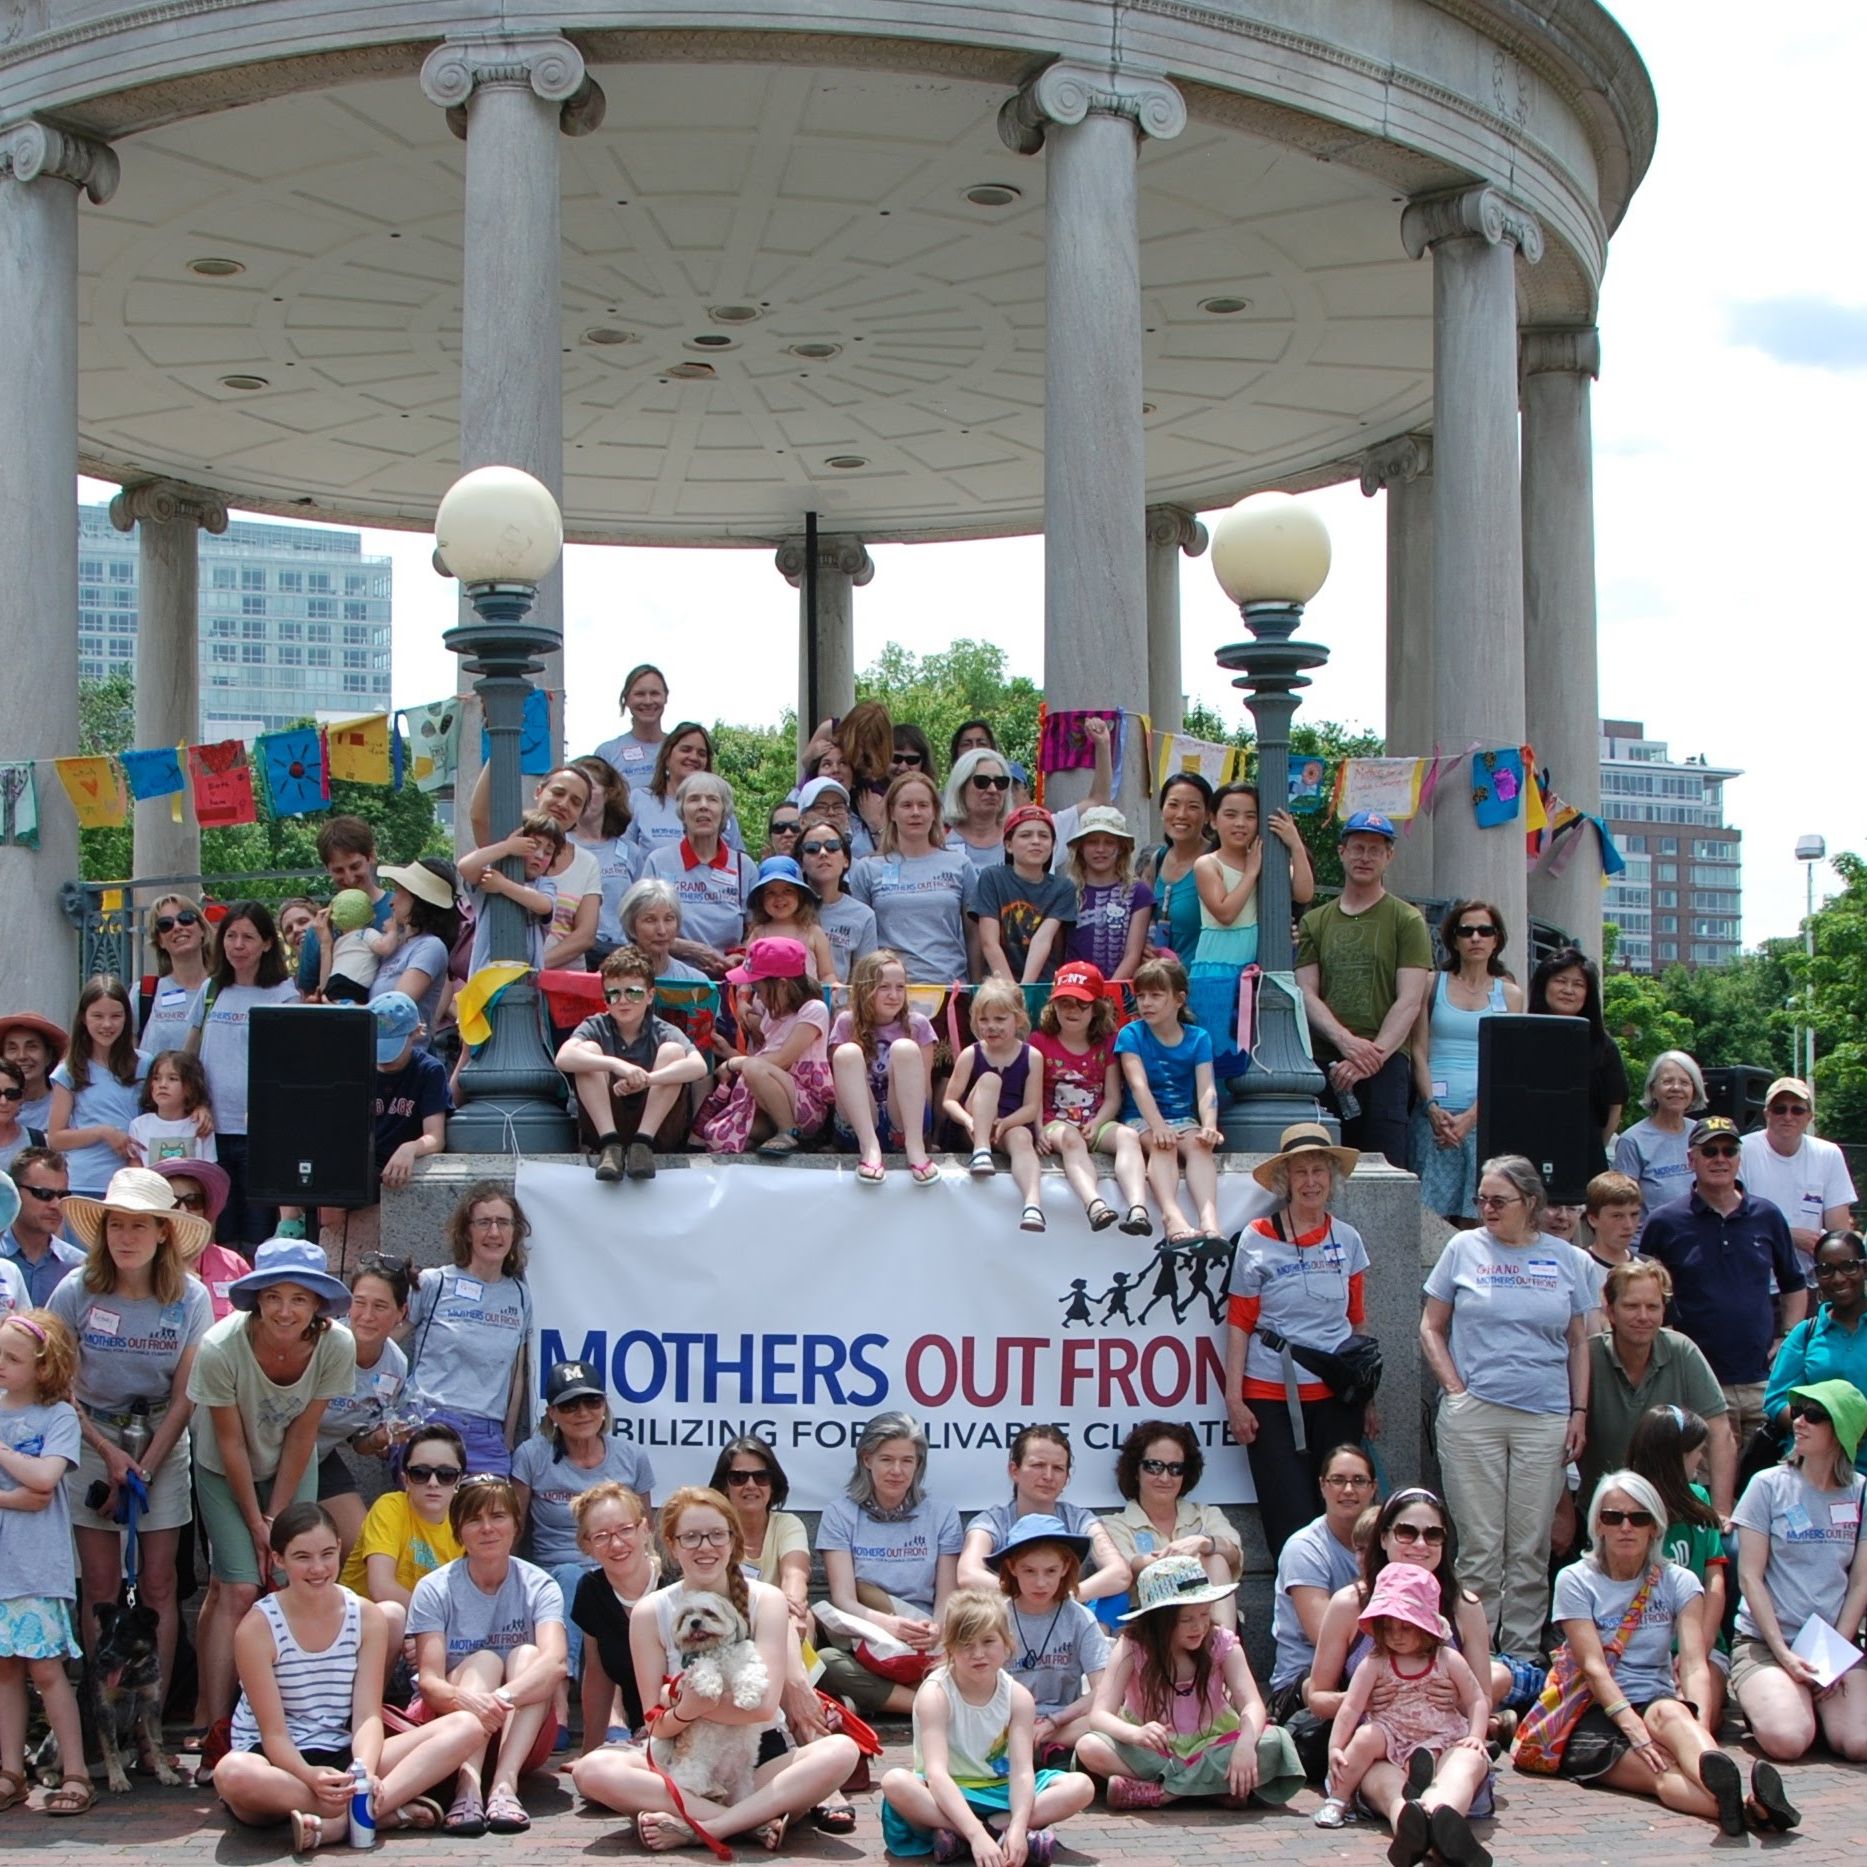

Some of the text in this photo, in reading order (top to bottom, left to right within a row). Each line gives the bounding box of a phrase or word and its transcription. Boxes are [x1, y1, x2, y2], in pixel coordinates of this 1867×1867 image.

[679, 892, 703, 901] THERS
[1477, 1264, 1520, 1275] GRAND
[1476, 1275, 1515, 1285] MOTHERS
[84, 1333, 127, 1348] MOTHERS
[128, 1336, 147, 1349] OUT
[148, 1339, 178, 1351] FRONT
[540, 1329, 1228, 1407] MOTHERS OUT FRON
[563, 1364, 584, 1382] M
[541, 1417, 777, 1448] BILIZING
[924, 1421, 1070, 1449] LIVAB
[1083, 1420, 1241, 1450] CLATE
[1826, 1528, 1842, 1539] OUT
[1843, 1529, 1857, 1540] FRO
[886, 1547, 902, 1558] OUT
[903, 1547, 928, 1557] FRONT
[1670, 1540, 1690, 1568] 10
[1644, 1612, 1670, 1624] FRON
[450, 1639, 487, 1650] MOTHE
[503, 1631, 529, 1644] FRONT
[1052, 1655, 1069, 1665] FRO
